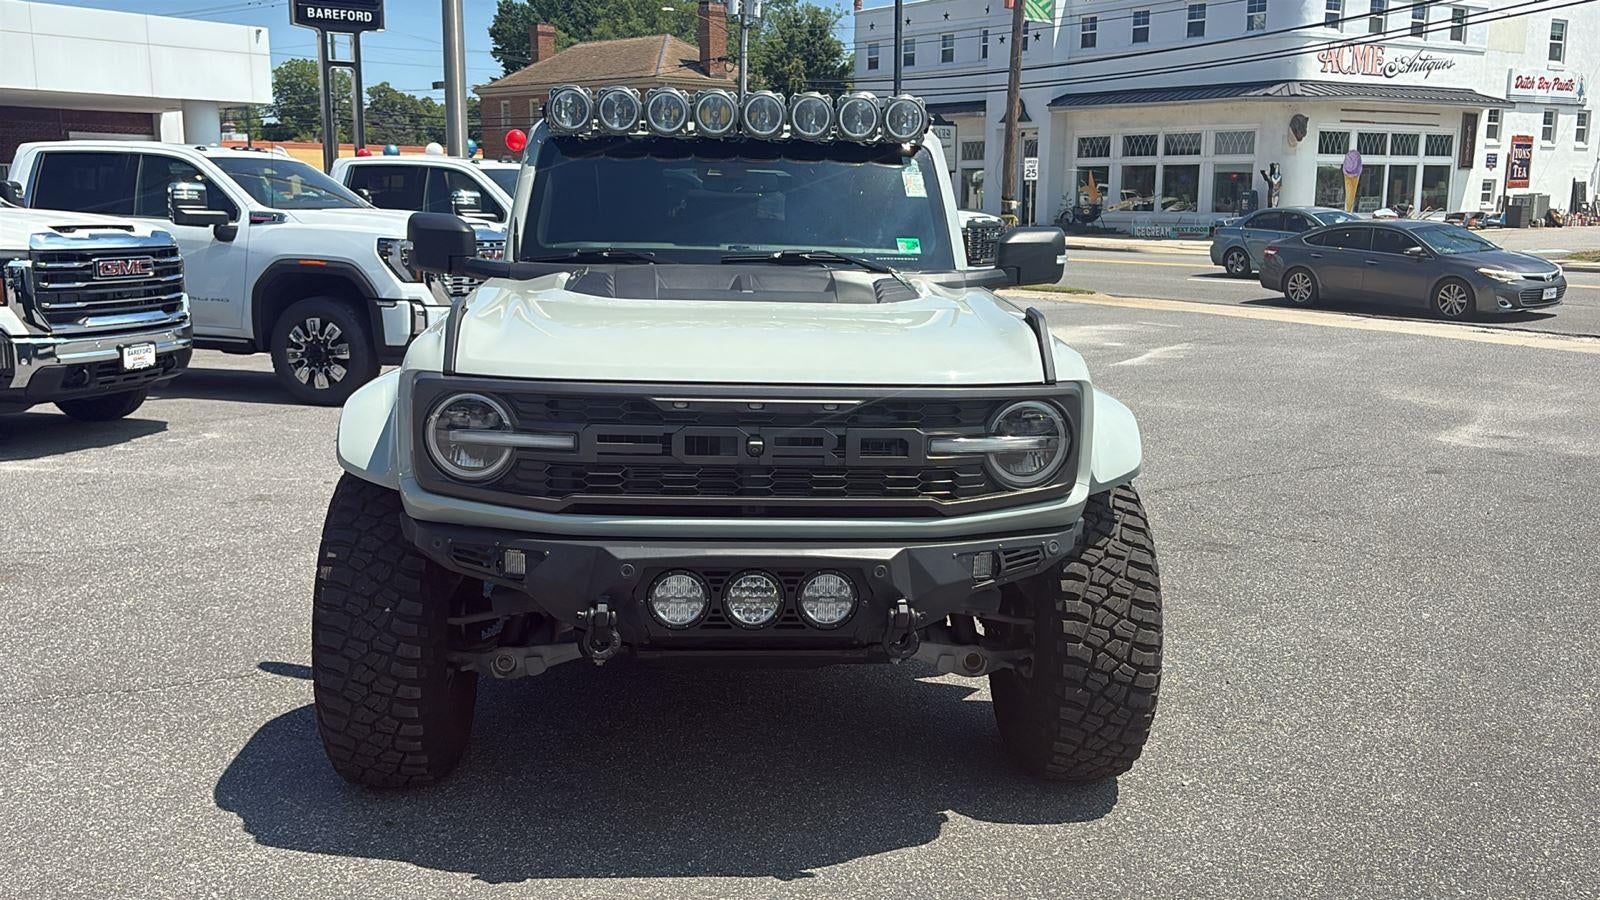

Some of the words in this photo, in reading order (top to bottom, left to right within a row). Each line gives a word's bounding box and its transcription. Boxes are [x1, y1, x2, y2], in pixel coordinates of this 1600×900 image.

[307, 7, 373, 22] BAREFORD
[1317, 43, 1385, 76] ACME
[1515, 75, 1535, 89] Dutch
[1537, 76, 1552, 93] Boy
[1552, 77, 1575, 92] Paints
[1026, 169, 1037, 178] 25
[1513, 164, 1527, 178] TEA
[100, 260, 153, 277] GMC
[579, 424, 925, 467] FORD
